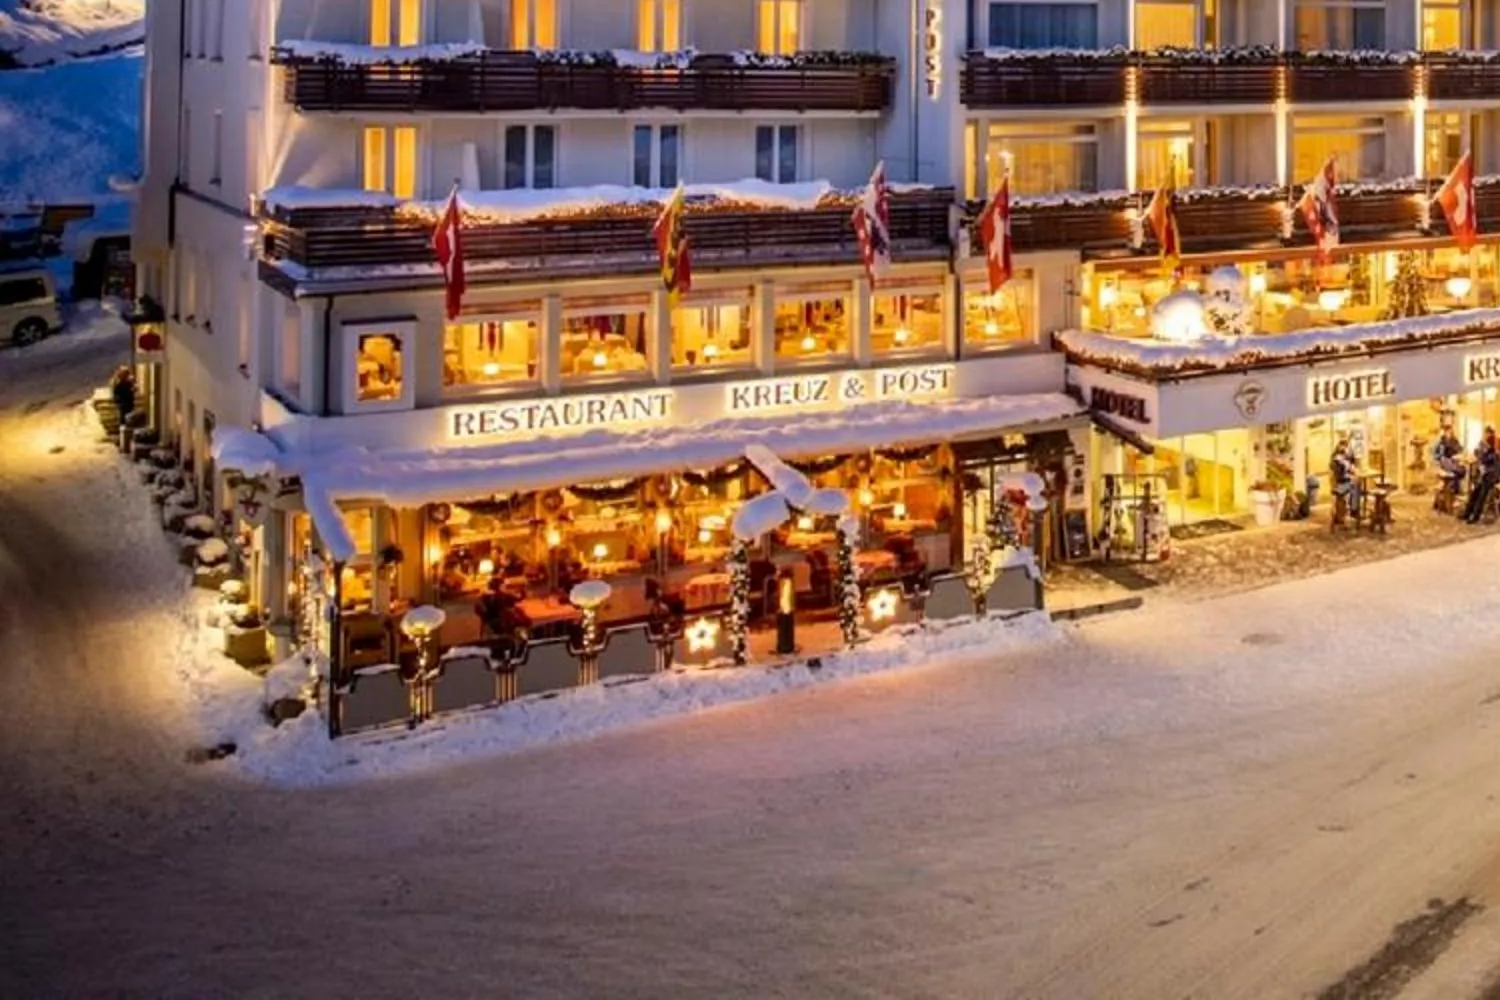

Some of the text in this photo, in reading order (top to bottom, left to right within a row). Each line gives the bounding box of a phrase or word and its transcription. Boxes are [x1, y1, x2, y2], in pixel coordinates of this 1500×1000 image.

[924, 8, 942, 99] POST
[451, 368, 954, 437] RESTAURANT KREUZ & POST
[1090, 386, 1152, 425] HOTEL
[1312, 371, 1396, 405] HOTEL
